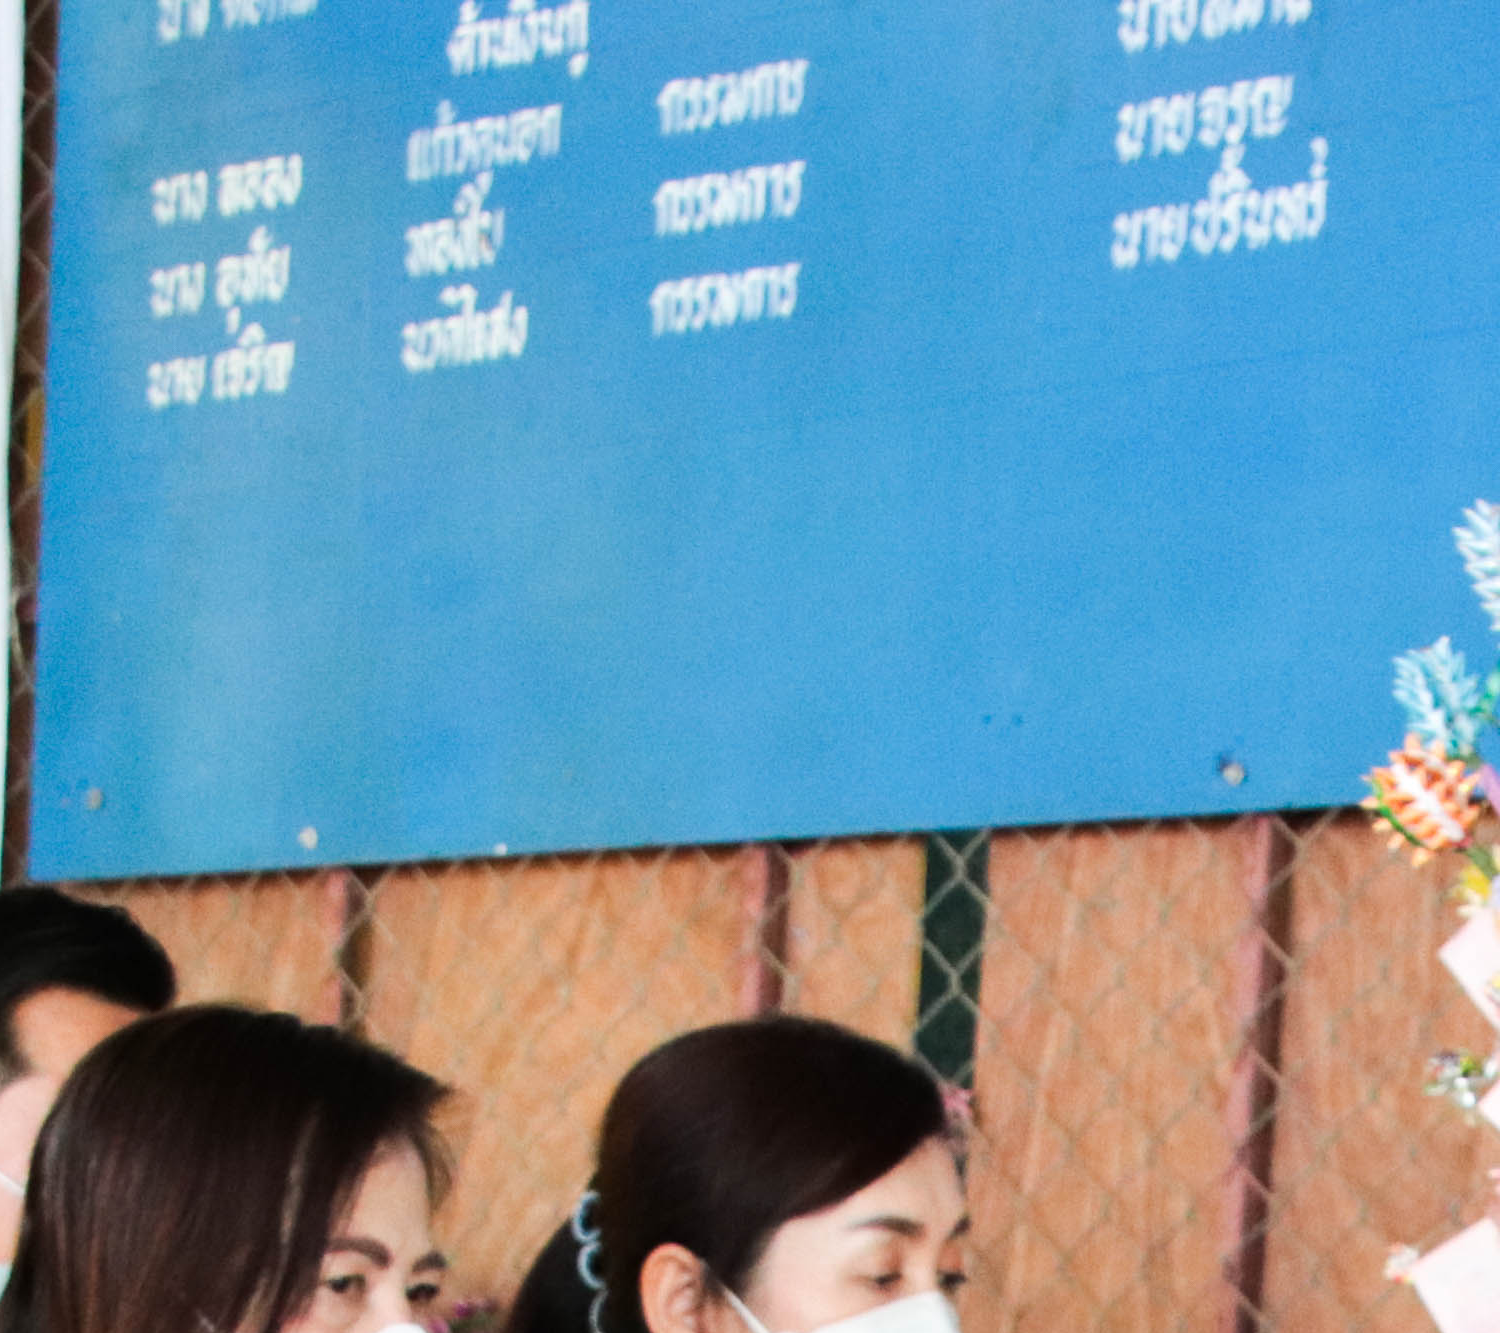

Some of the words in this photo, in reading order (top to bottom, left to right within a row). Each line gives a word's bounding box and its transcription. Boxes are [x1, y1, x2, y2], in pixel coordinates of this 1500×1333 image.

[655, 58, 810, 134] กรรมการ
[652, 159, 807, 237] กรรมการ
[648, 262, 802, 339] กรรมการ
